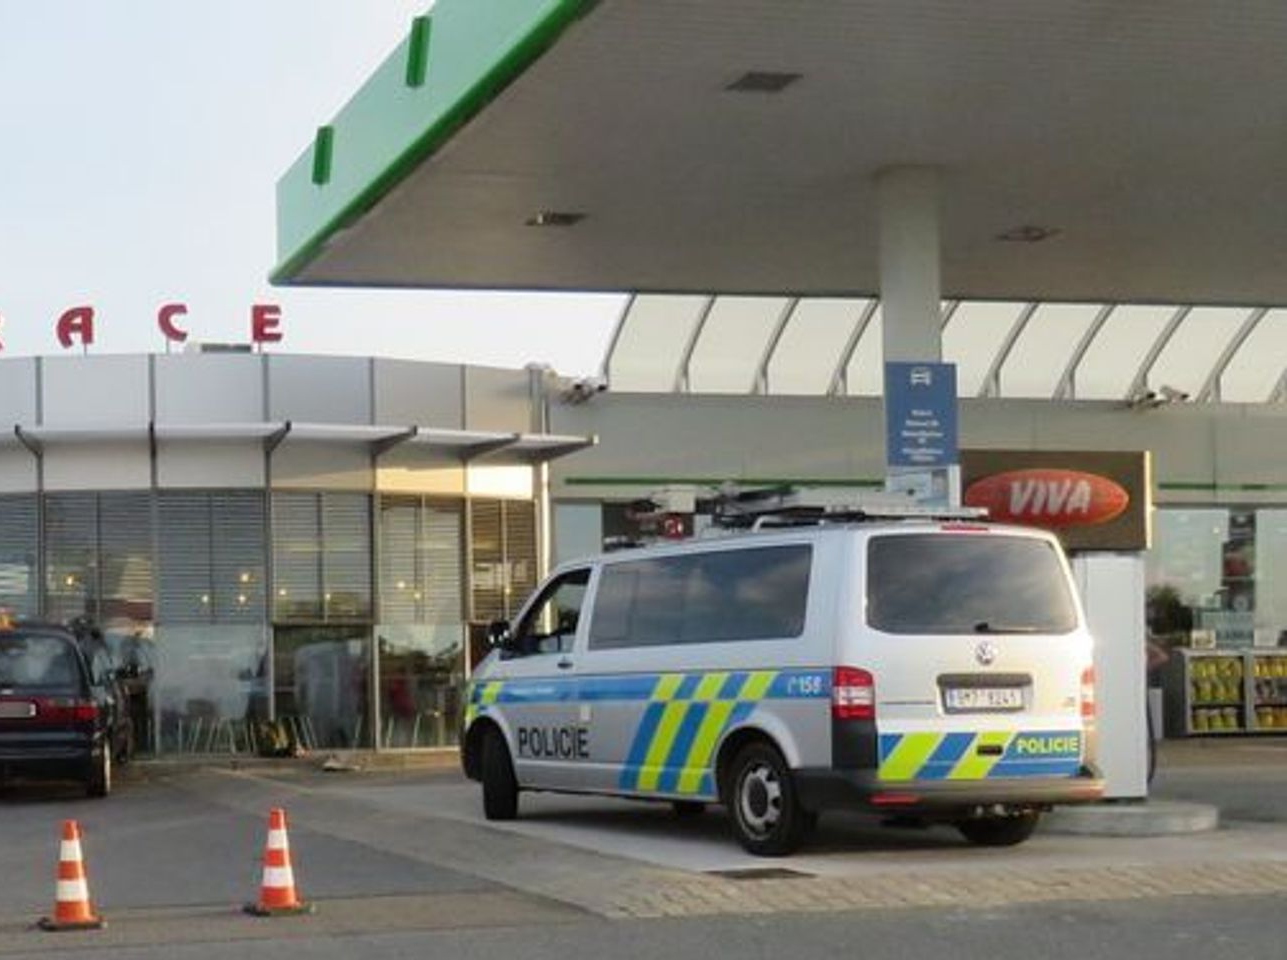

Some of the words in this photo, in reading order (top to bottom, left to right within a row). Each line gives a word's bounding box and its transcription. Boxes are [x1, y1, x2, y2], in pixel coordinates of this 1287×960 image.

[1008, 479, 1092, 515] VIVA
[517, 725, 591, 759] POLICIE
[1017, 737, 1080, 754] POLICIE
